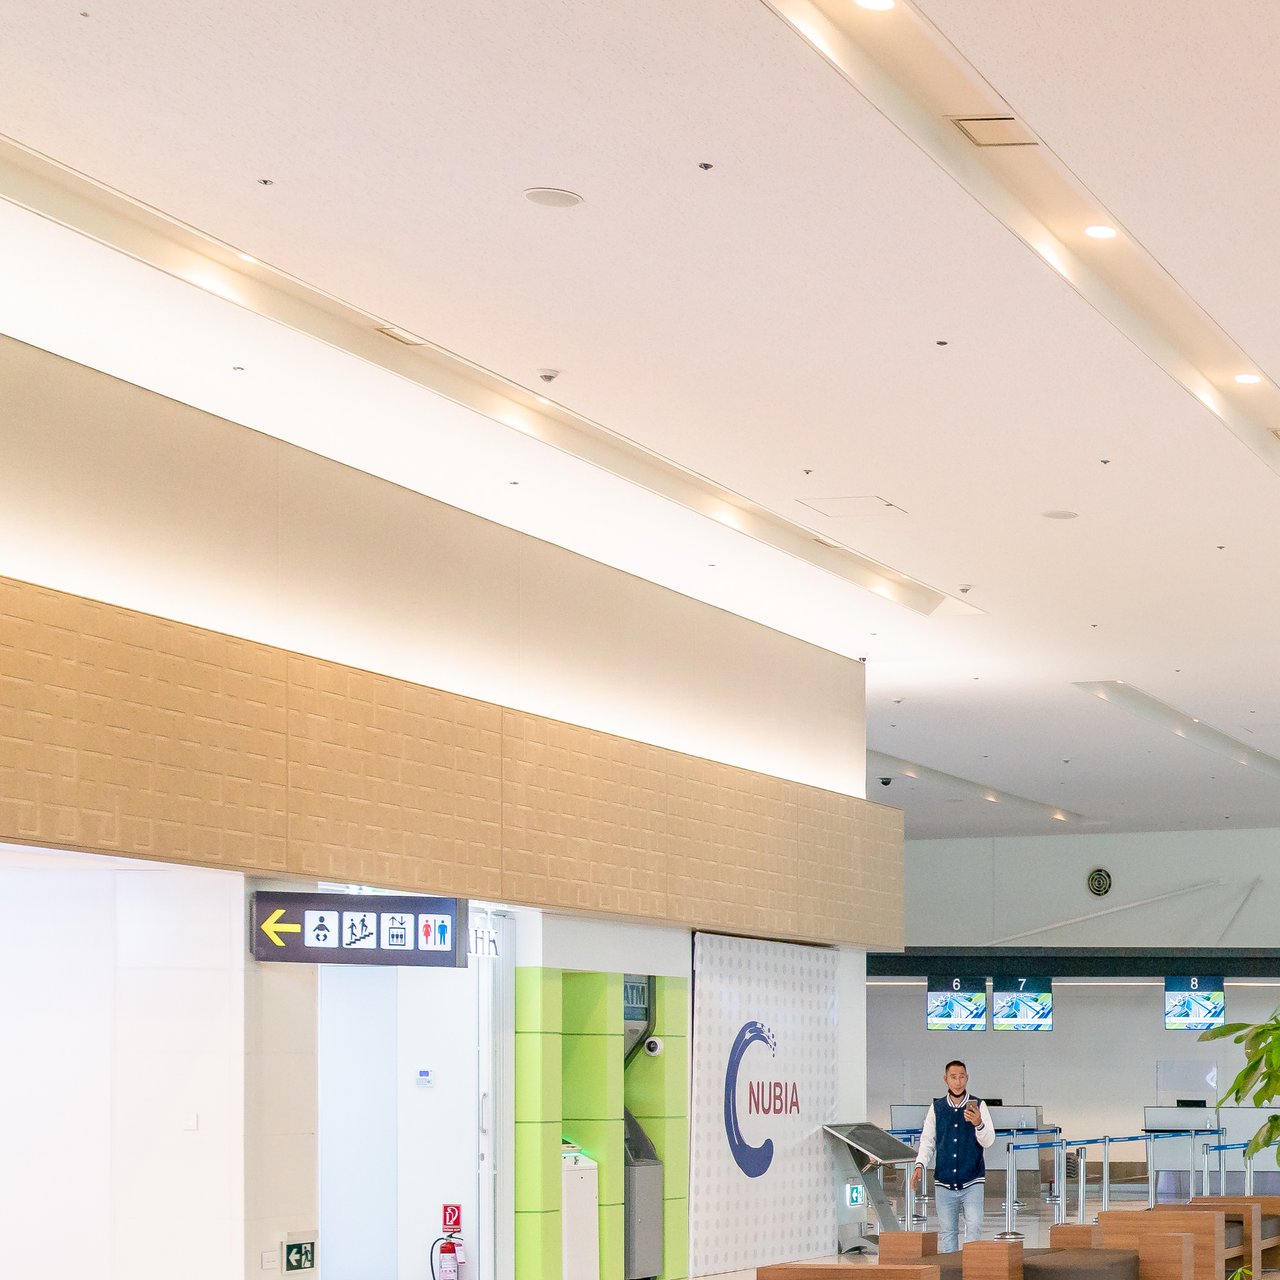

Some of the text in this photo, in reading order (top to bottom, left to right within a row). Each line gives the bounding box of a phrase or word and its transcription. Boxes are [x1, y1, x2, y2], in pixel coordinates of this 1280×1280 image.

[952, 978, 961, 991] 6
[1018, 978, 1027, 991] 7
[1190, 977, 1199, 990] 8
[748, 1080, 800, 1115] NUBIA
